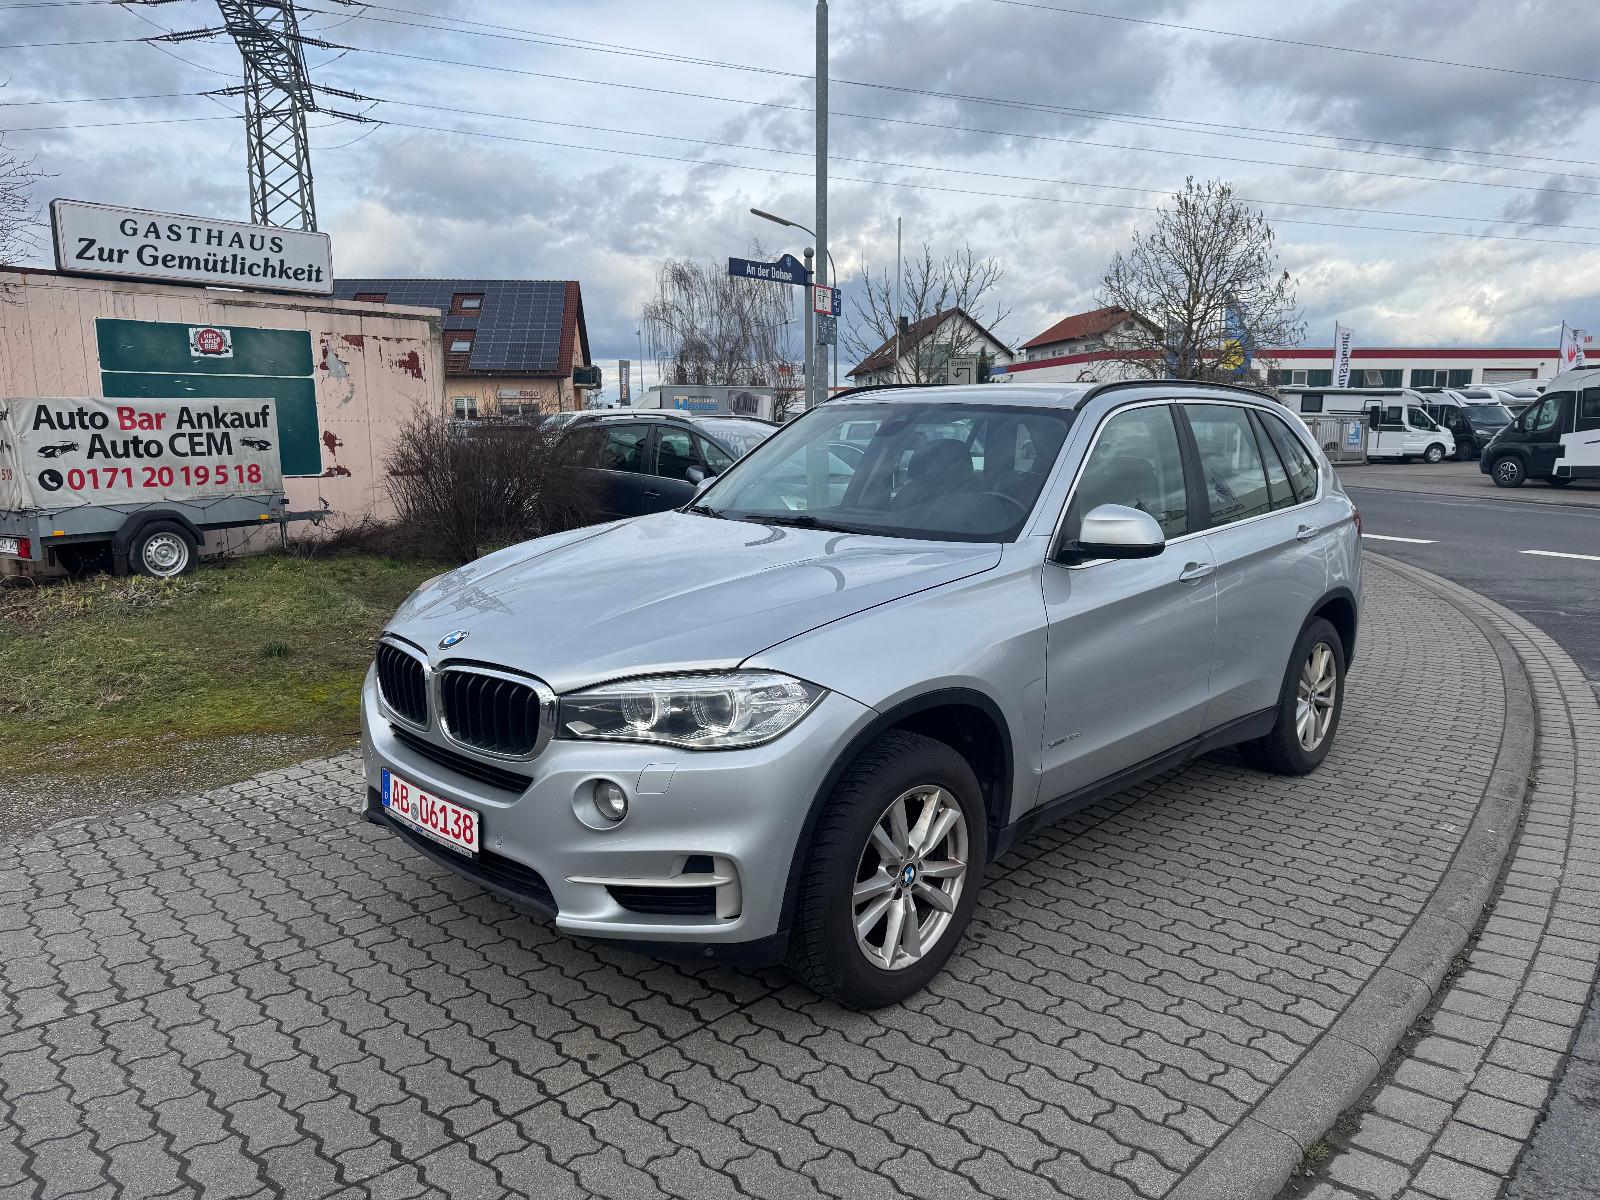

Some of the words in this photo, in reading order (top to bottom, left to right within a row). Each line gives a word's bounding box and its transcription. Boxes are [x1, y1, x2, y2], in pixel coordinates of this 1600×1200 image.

[120, 218, 283, 254] GASTHAUS
[75, 237, 130, 264] Zur
[136, 243, 324, 283] Gemütlichkeit
[746, 262, 756, 276] An
[757, 264, 770, 278] der
[771, 266, 793, 281] Dohne
[519, 389, 539, 398] ERGO
[32, 404, 110, 431] Auto
[116, 406, 167, 431] Bar
[176, 404, 270, 430] Ankauf
[86, 433, 164, 460] Auto
[168, 431, 234, 458] CEM
[67, 467, 134, 491] 0171
[392, 779, 410, 814] AB
[419, 794, 474, 845] 06138
